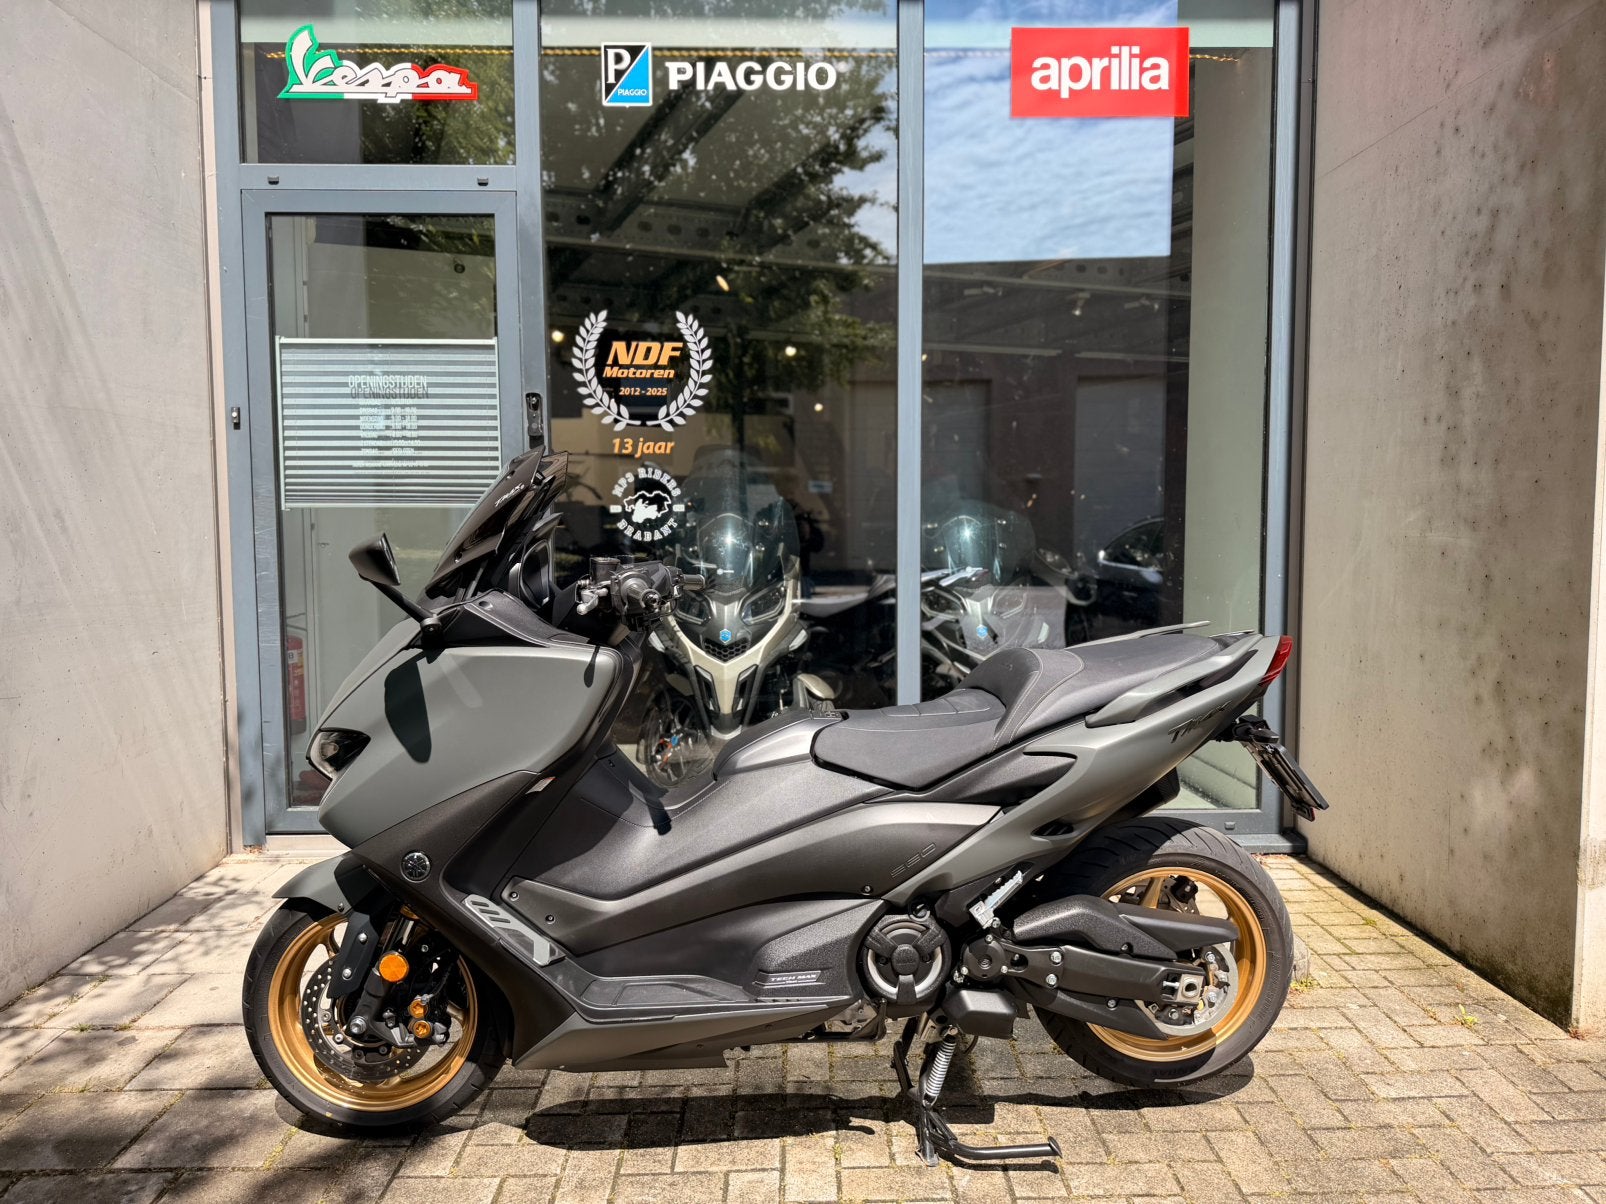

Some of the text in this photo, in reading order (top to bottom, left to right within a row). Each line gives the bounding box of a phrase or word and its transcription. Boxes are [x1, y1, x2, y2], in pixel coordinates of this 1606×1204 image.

[288, 29, 473, 98] Vespa
[606, 48, 631, 84] P
[665, 60, 837, 91] PIAGGIO
[1030, 45, 1170, 99] aprilia
[617, 88, 648, 97] PIAGGIO
[606, 341, 683, 366] NDF
[602, 366, 675, 378] Motoren
[613, 438, 675, 458] 13 jaar
[612, 467, 682, 497] MP3 RIDERS
[616, 517, 678, 542] BRABANT
